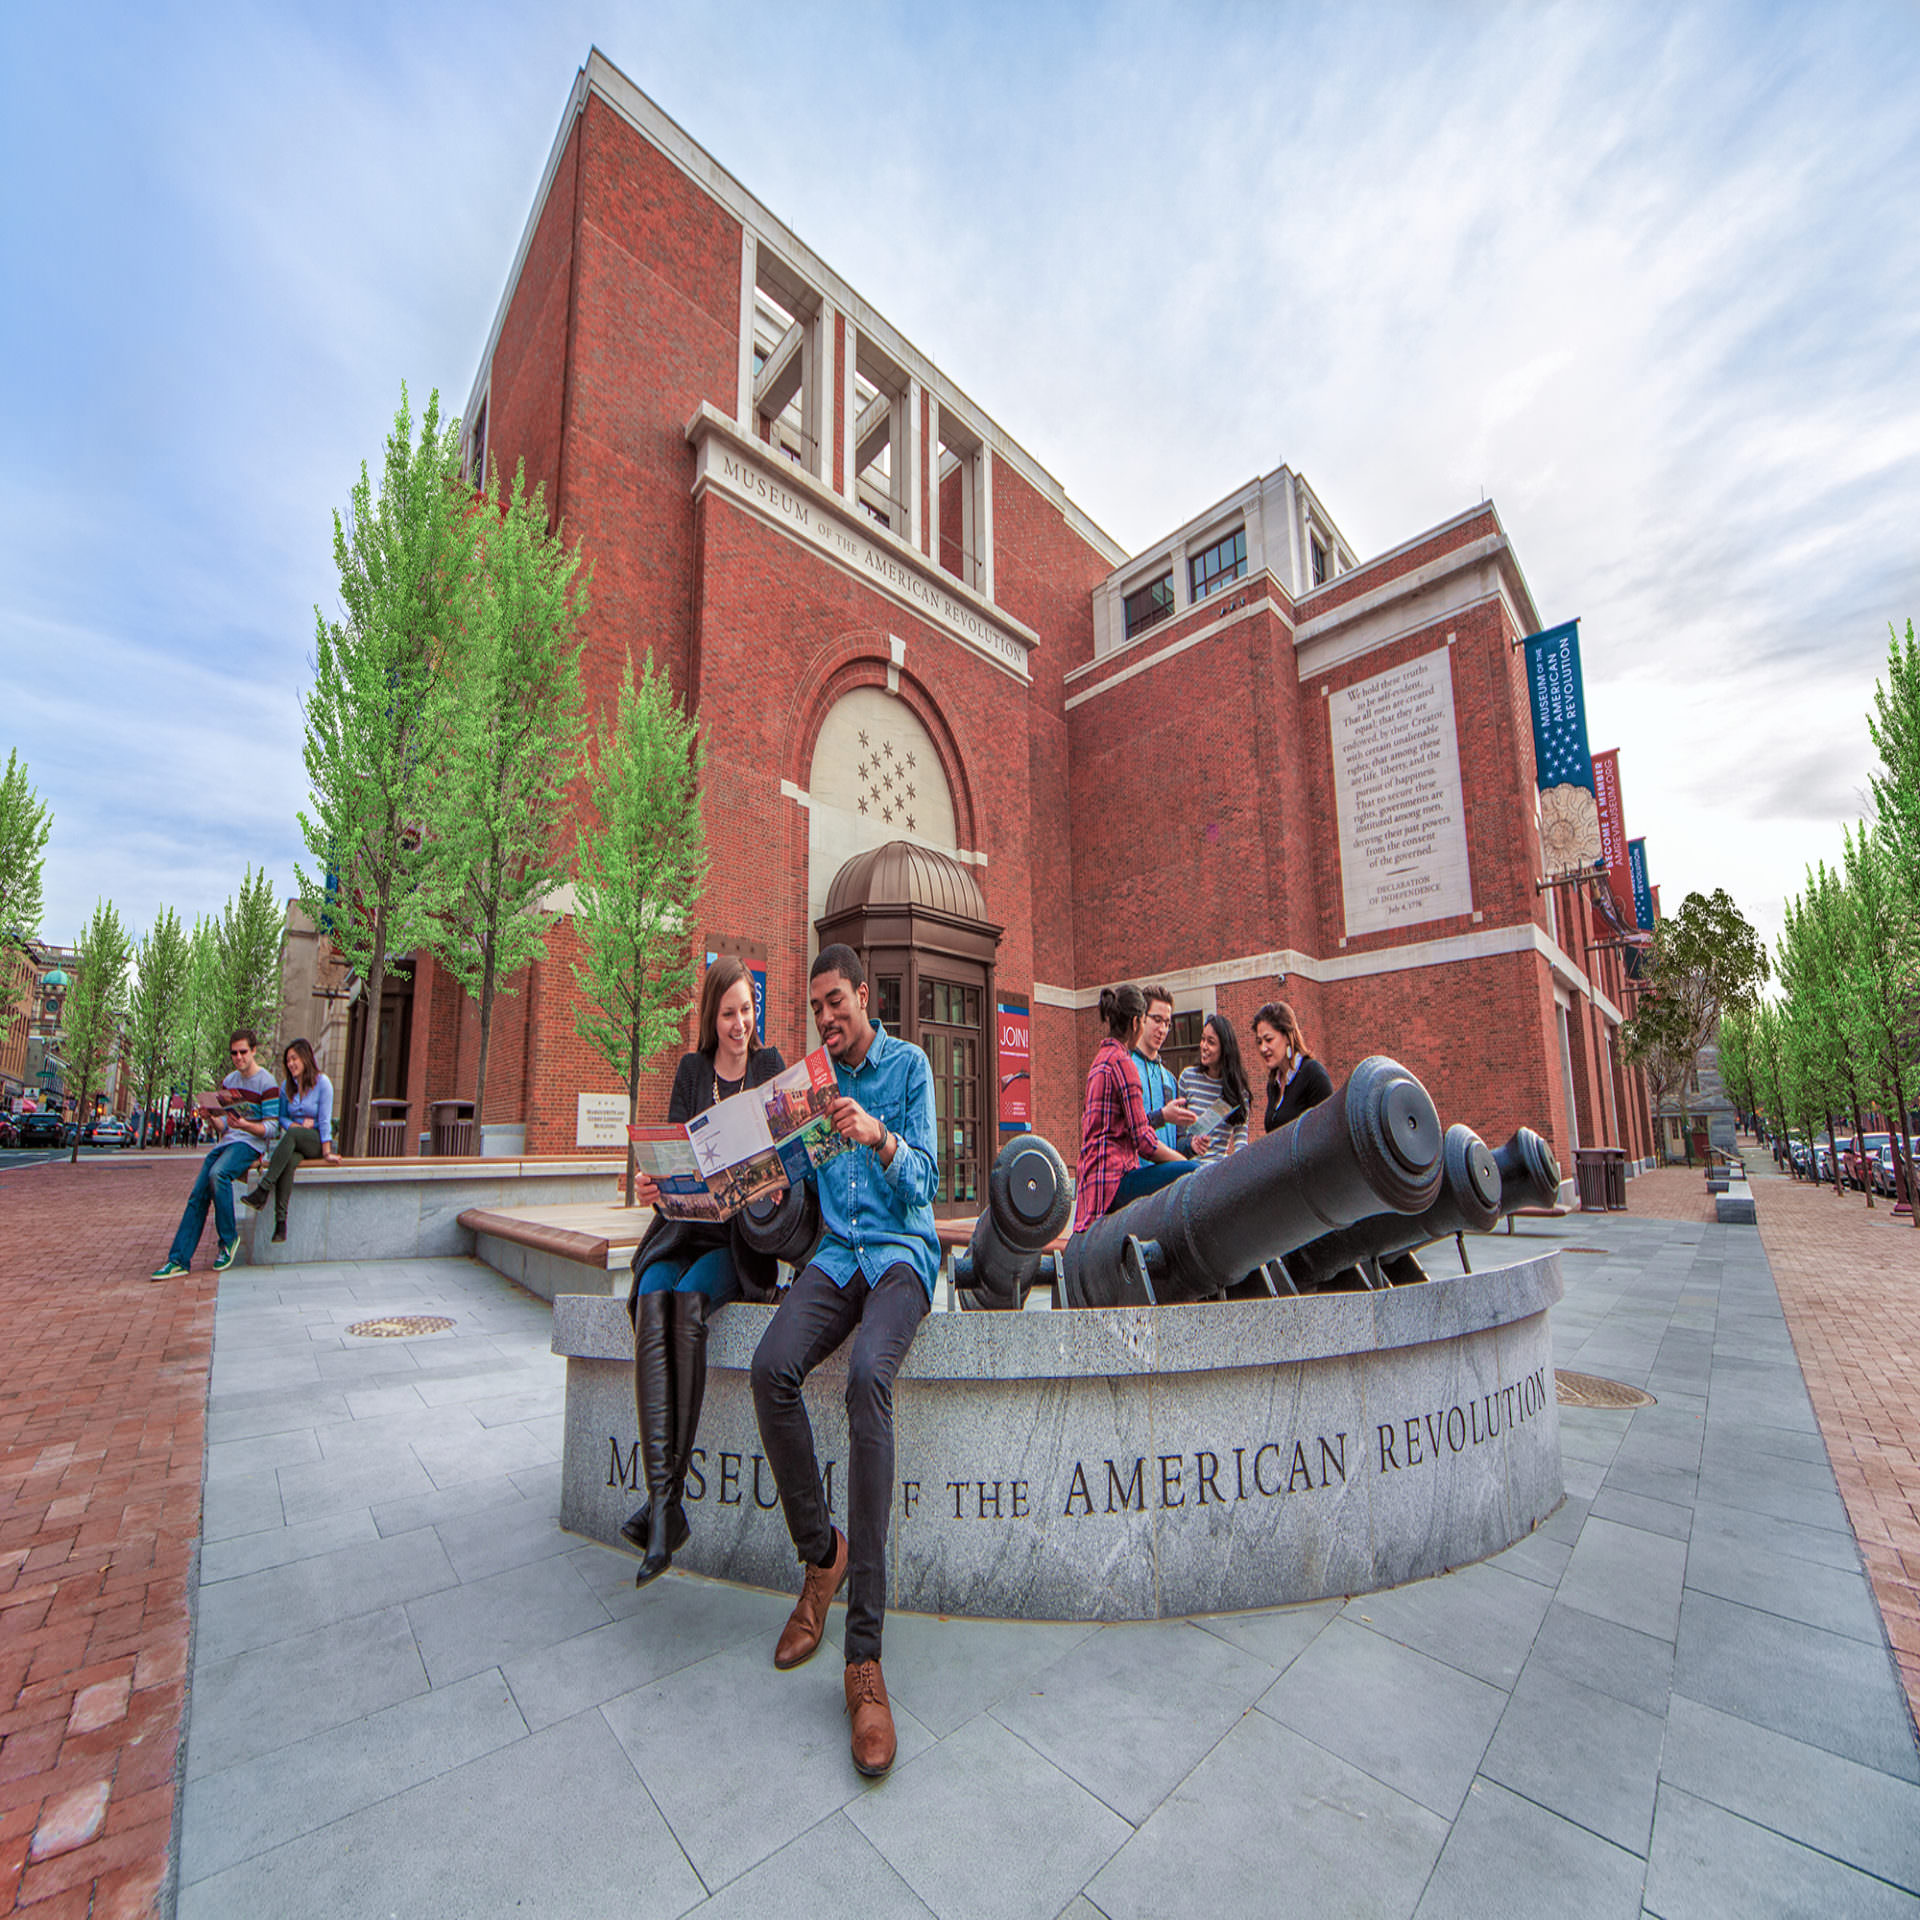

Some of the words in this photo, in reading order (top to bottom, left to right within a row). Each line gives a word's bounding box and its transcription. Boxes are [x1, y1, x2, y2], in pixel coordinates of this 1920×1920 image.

[724, 456, 808, 525] MUSEUM
[818, 524, 832, 539] OF
[836, 534, 857, 556] THE
[864, 550, 940, 610] AMERICAN
[944, 604, 1022, 662] REVOLUTION
[1538, 662, 1544, 672] OF
[1560, 638, 1576, 718] REVOLUTION
[1348, 688, 1360, 701] We
[1362, 682, 1379, 697] hold
[1381, 676, 1400, 690] these
[1403, 664, 1428, 680] truths
[1548, 653, 1562, 722] AMERICAN
[1344, 715, 1360, 727] That
[1363, 709, 1371, 720] all
[1374, 705, 1390, 715] men
[1393, 699, 1404, 709] are
[1406, 684, 1434, 704] created
[1379, 714, 1394, 726] that
[1397, 708, 1412, 719] they
[1416, 703, 1426, 712] are
[1539, 674, 1551, 728] MUSEUM
[1391, 723, 1409, 735] their
[1412, 711, 1445, 728] Creator,
[1347, 751, 1363, 762] with
[1365, 742, 1391, 756] certain
[1394, 724, 1438, 746] unalienable
[1372, 756, 1387, 767] that
[1391, 746, 1418, 761] among
[1419, 738, 1440, 751] these
[1352, 777, 1361, 786] are
[1409, 754, 1425, 766] and
[1427, 750, 1440, 761] the
[1356, 784, 1382, 800] pursuit
[1385, 776, 1393, 789] of
[1356, 799, 1375, 810] That
[1388, 788, 1412, 800] secure
[1416, 781, 1436, 792] these
[1594, 762, 1607, 806] MEMBER
[1379, 795, 1429, 818] governments
[1432, 791, 1443, 800] are
[1600, 810, 1608, 818] A
[1353, 834, 1383, 848] deriving
[1384, 829, 1402, 840] their
[1404, 824, 1419, 836] just
[1422, 816, 1450, 832] powers
[1356, 815, 1392, 833] instituted
[1394, 809, 1421, 823] among
[1366, 846, 1385, 856] from
[1387, 841, 1400, 851] the
[1402, 832, 1435, 847] consent
[1602, 822, 1614, 868] BECOME
[1370, 857, 1379, 868] of
[1380, 856, 1392, 866] the
[1377, 876, 1430, 894] DECLARATION
[1381, 884, 1440, 903] INDEPENDENCE
[1000, 1026, 1028, 1048] JOIN!
[606, 1436, 836, 1514] MSEU
[946, 1480, 1030, 1520] THE
[1063, 1432, 1349, 1518] AMERICAN
[1376, 1366, 1547, 1474] REVOLUTION
